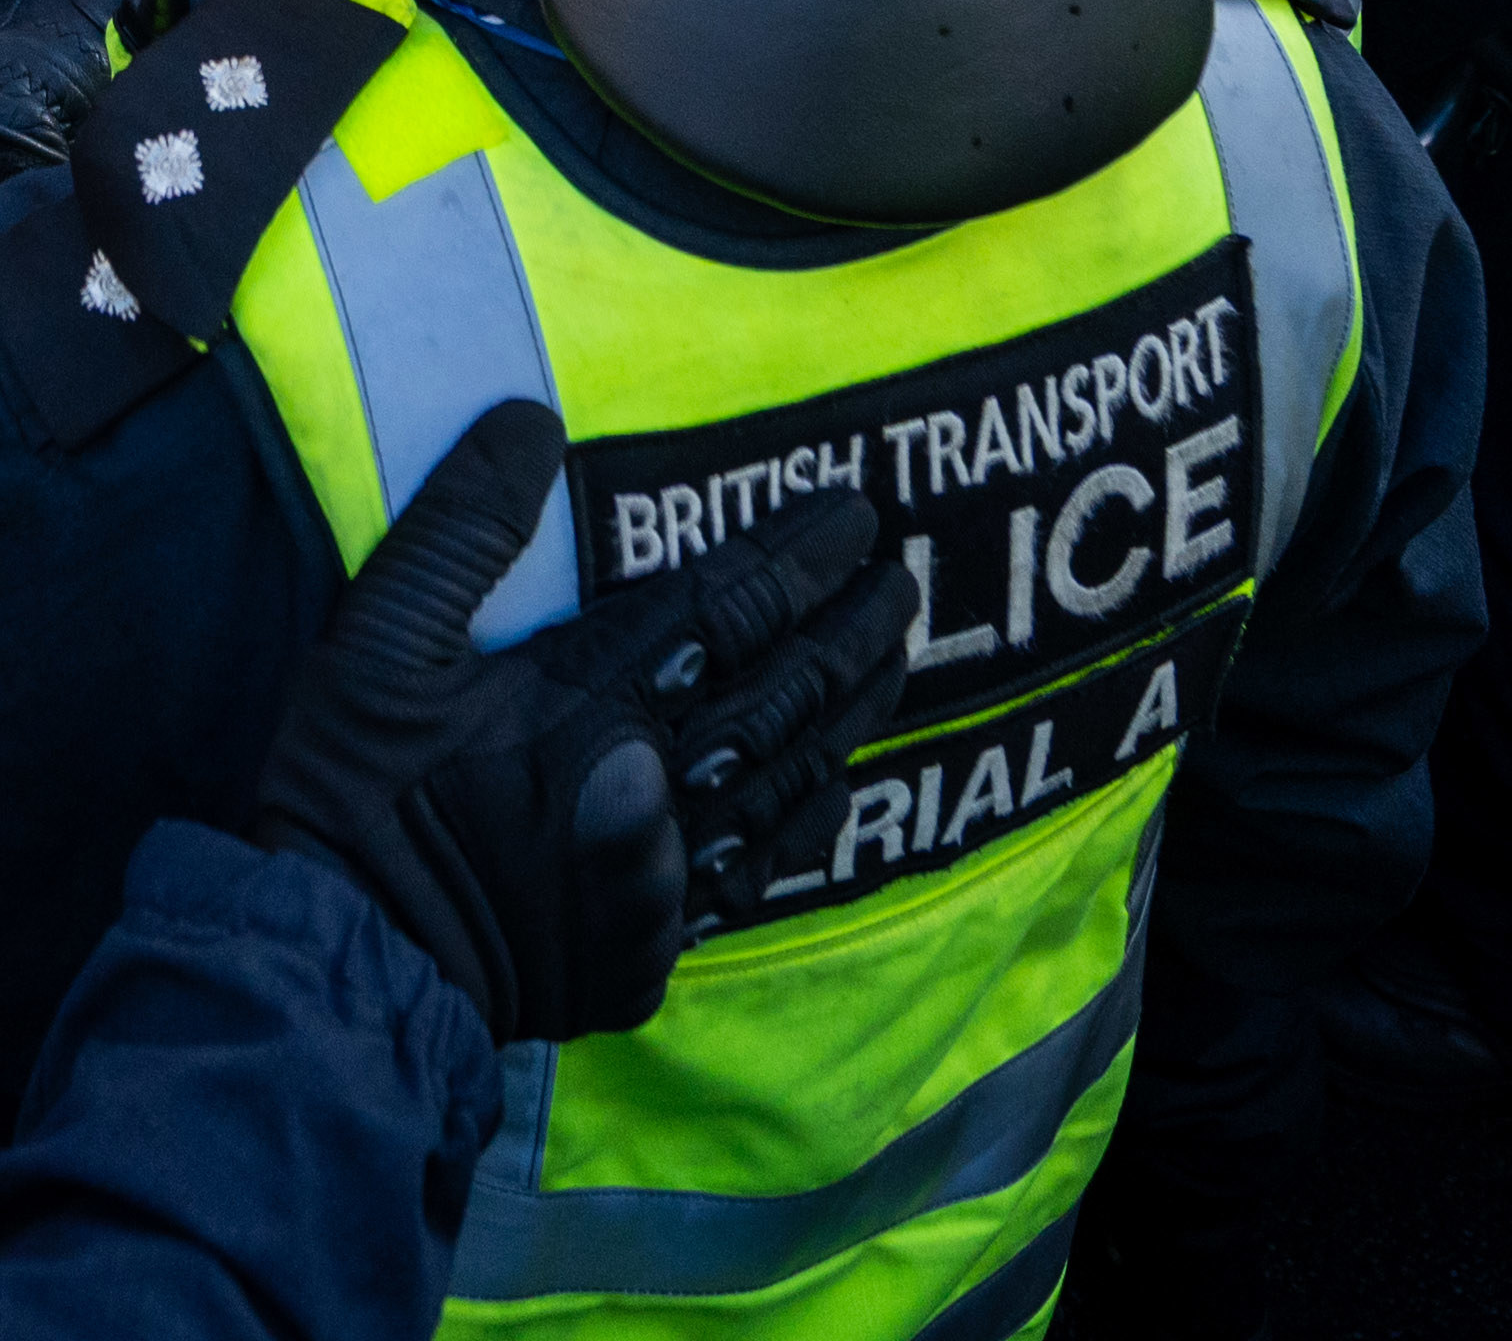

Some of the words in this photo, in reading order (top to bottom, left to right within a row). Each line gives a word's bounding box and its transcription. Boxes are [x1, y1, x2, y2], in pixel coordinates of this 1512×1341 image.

[615, 434, 865, 578] BRITISH
[882, 293, 1239, 507] TRANSPORT
[902, 415, 1239, 672] LICE
[764, 719, 1073, 900] RIAL
[1114, 659, 1178, 761] A
